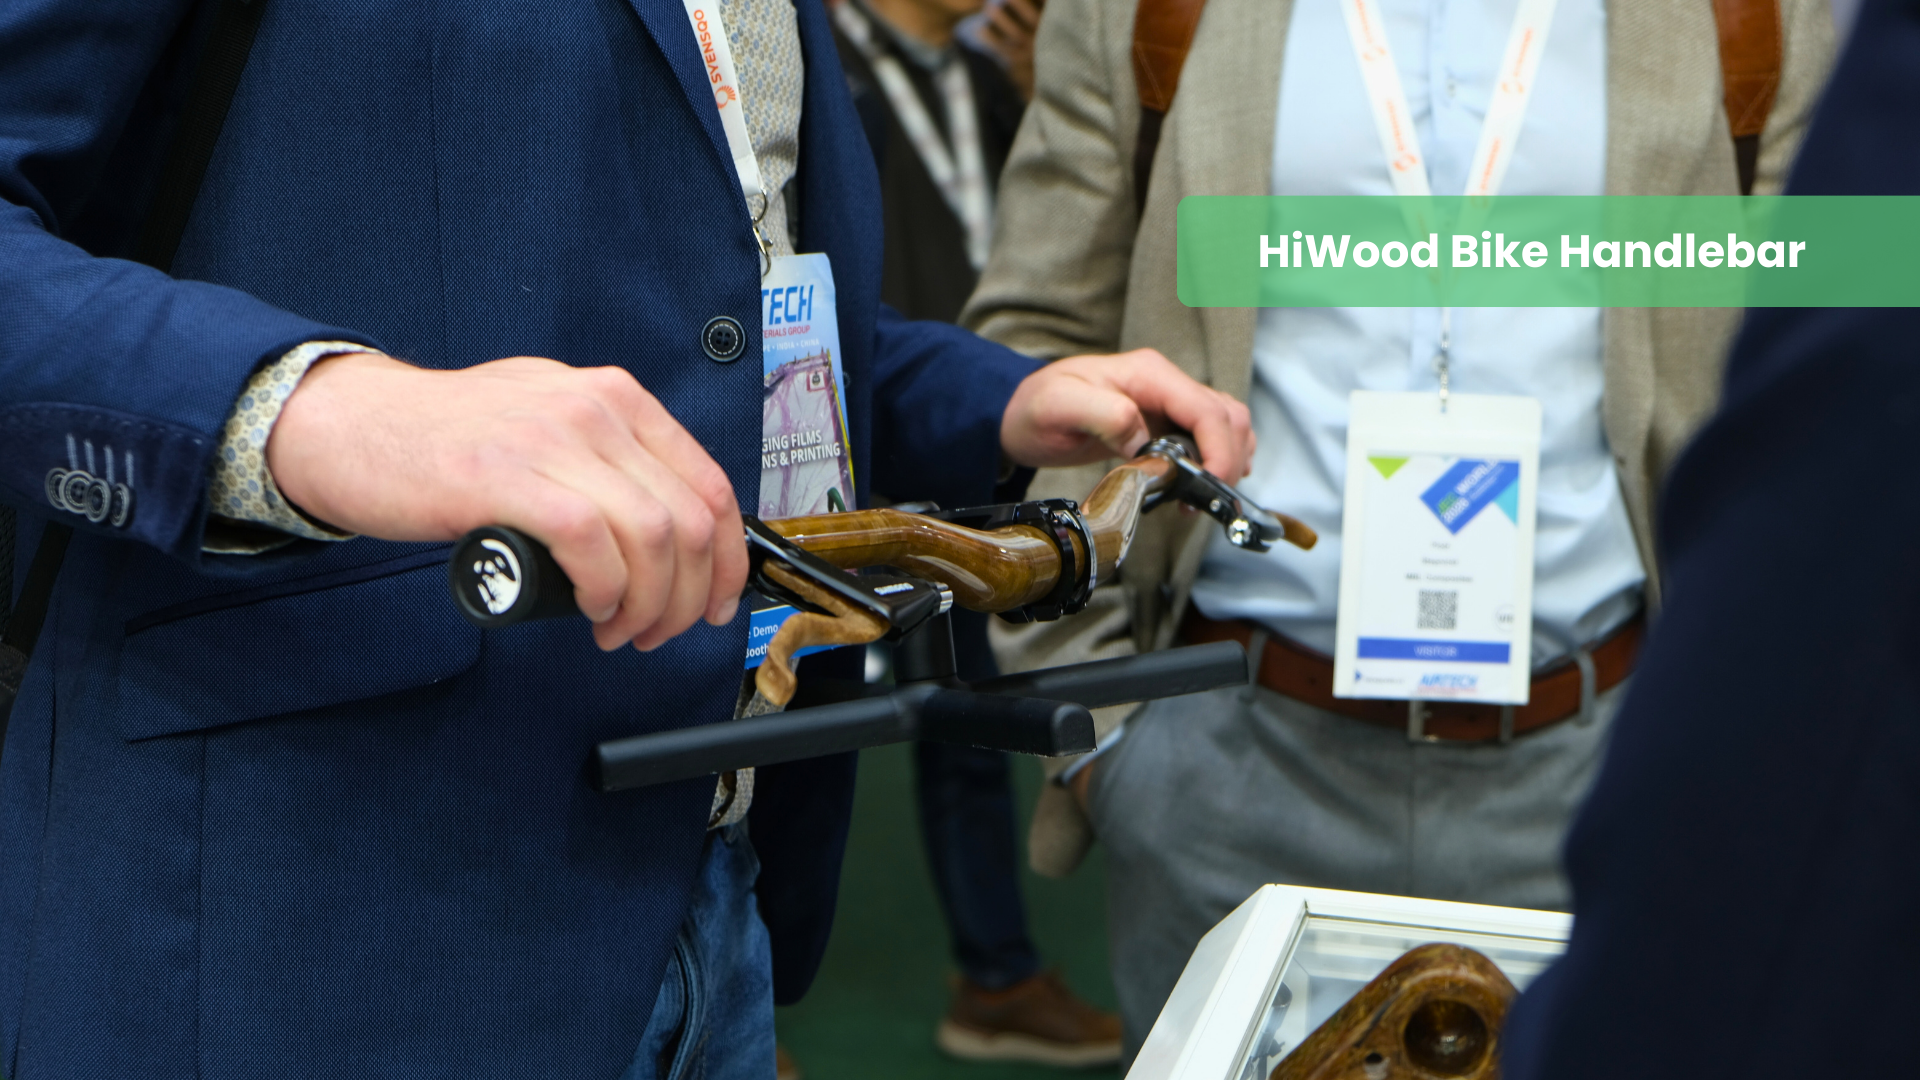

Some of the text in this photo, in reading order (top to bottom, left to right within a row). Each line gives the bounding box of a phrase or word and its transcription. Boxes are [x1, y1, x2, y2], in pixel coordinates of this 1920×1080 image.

[693, 9, 722, 84] SYENSQO
[788, 325, 811, 336] GROUP
[776, 341, 795, 350] INDIA
[801, 338, 820, 348] CHINA
[791, 429, 822, 448] FILMS
[762, 442, 841, 469] NS & PRINTING
[753, 624, 779, 638] Demo
[1414, 645, 1457, 658] VISITOR
